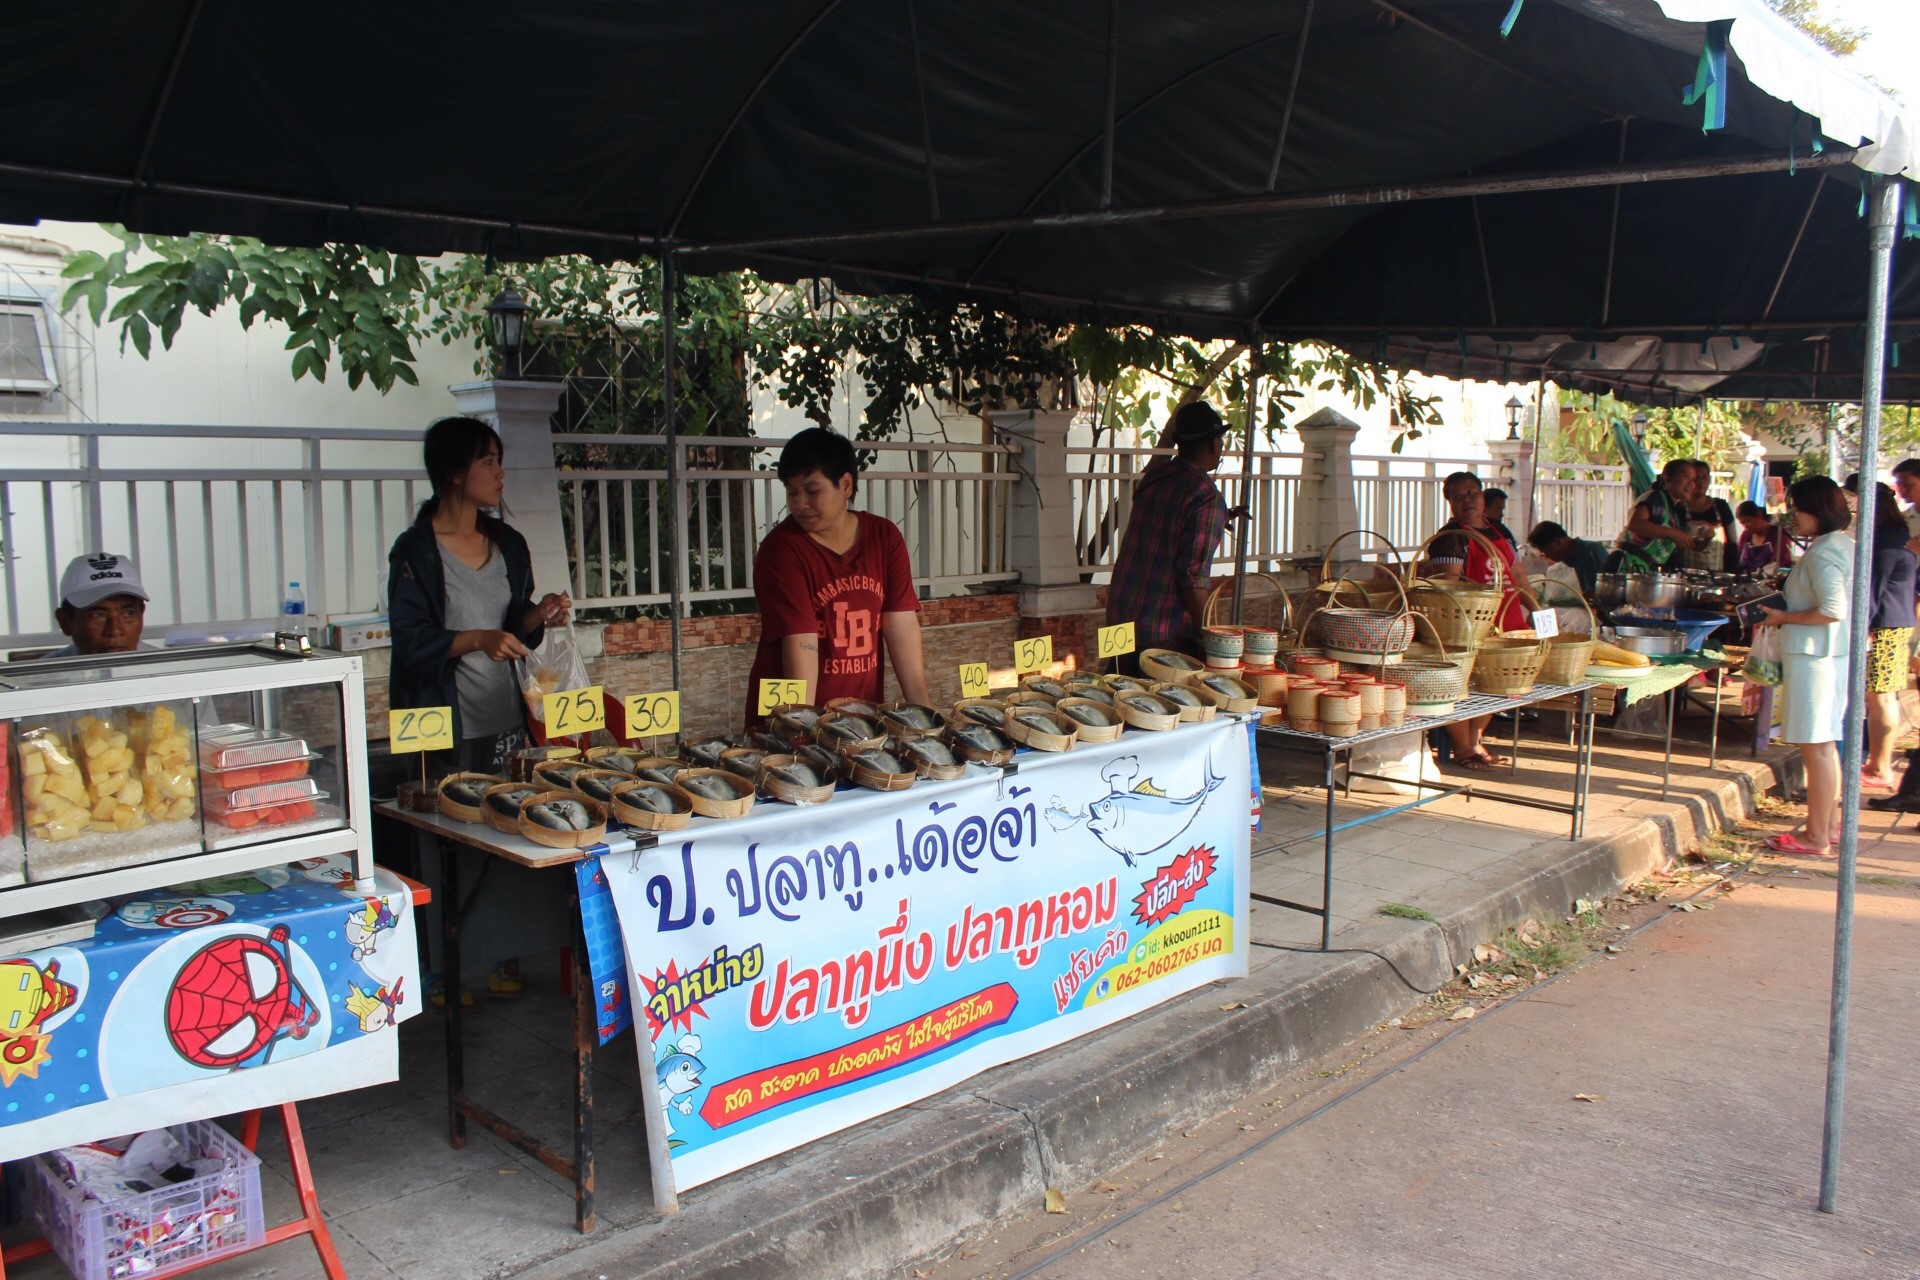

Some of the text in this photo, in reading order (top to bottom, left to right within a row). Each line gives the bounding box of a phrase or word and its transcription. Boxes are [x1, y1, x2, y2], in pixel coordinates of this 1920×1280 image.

[90, 571, 123, 581] adidas
[833, 601, 873, 657] IB
[764, 681, 800, 710] 35
[646, 841, 715, 932] ป.
[1146, 854, 1204, 917] ปลีก-ส่ง
[748, 877, 1117, 1027] ปลาทูนึ่ง ปลาทูหอม
[1163, 915, 1221, 949] kkooun1111
[648, 944, 763, 1025] จำหน่าย
[1116, 937, 1223, 992] 062-0602765 มด
[724, 1087, 753, 1115] สด
[760, 1066, 820, 1100] สะอาด
[828, 1033, 903, 1078] ปลอดภัย
